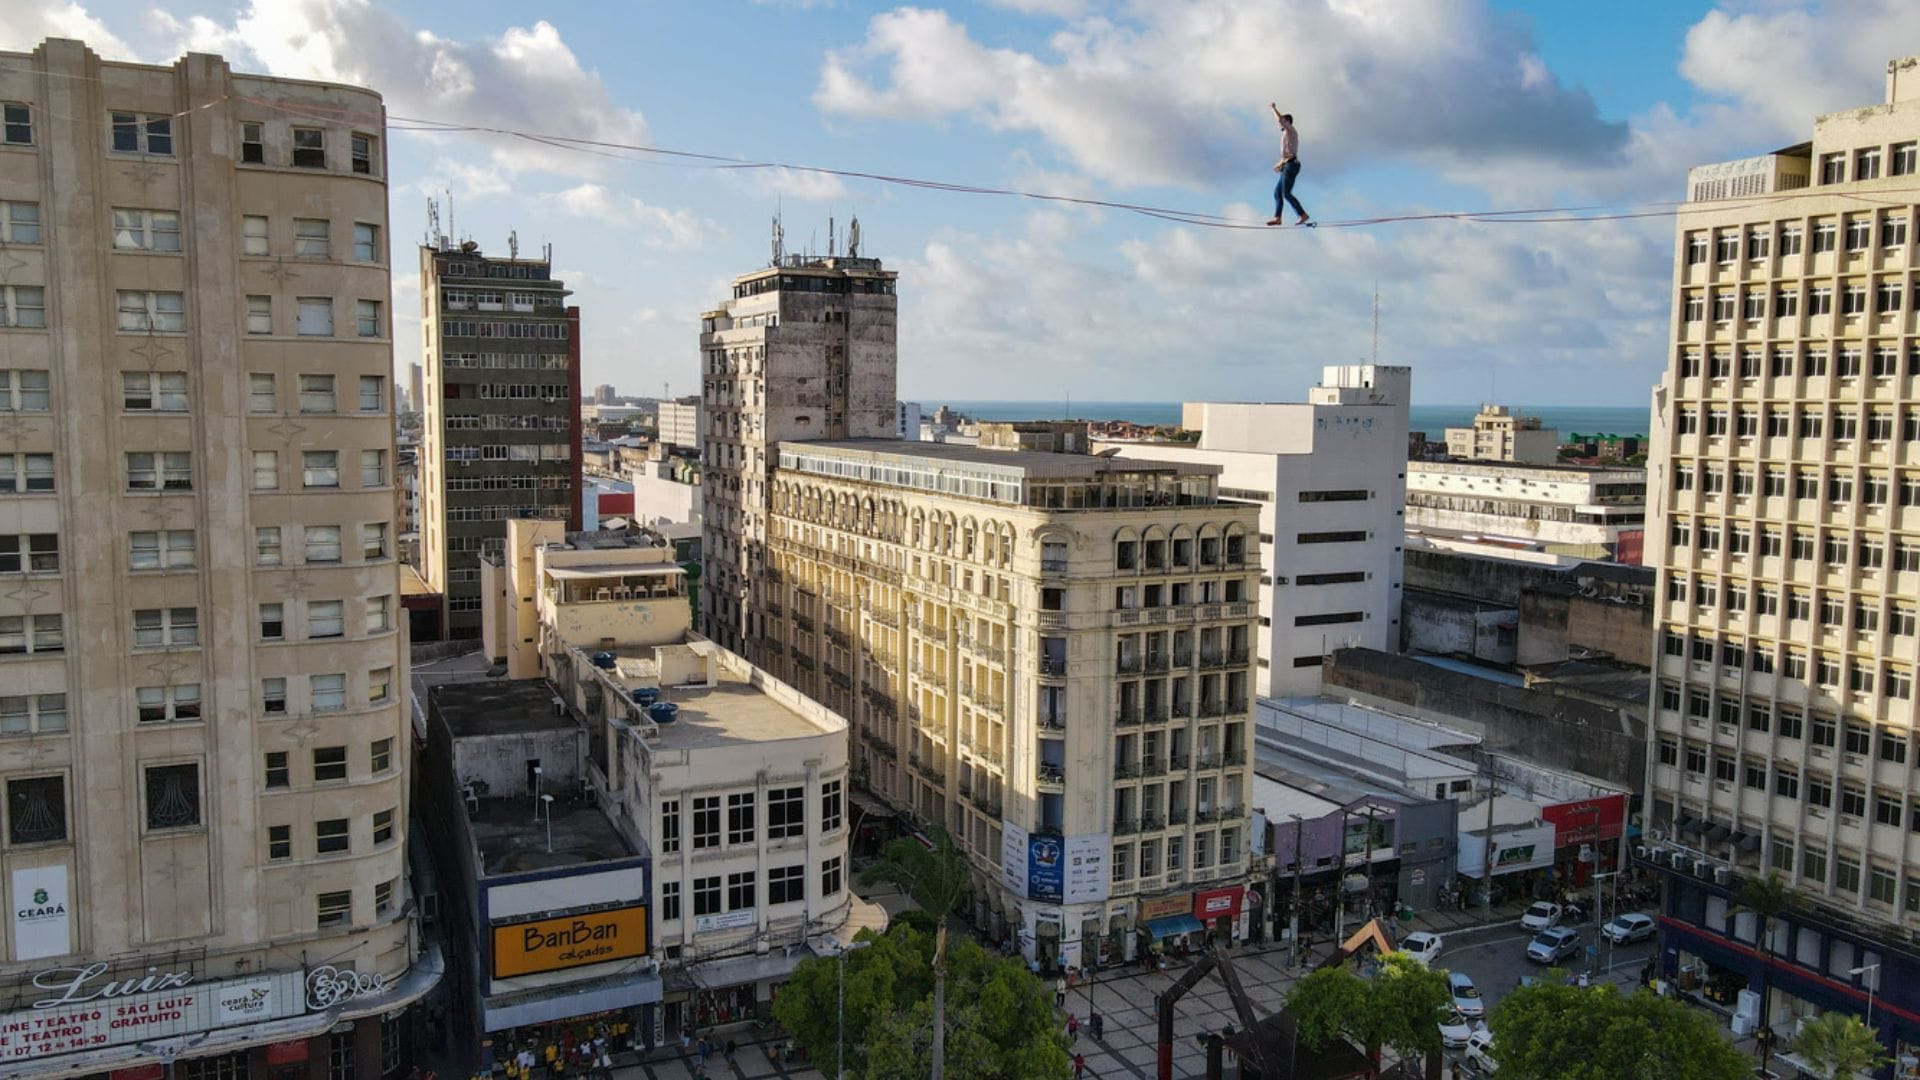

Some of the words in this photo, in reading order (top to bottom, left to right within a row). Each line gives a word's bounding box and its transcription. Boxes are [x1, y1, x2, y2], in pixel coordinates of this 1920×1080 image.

[18, 903, 65, 918] CEARÁ
[524, 920, 618, 953] BanBan
[558, 945, 614, 961] calçados
[32, 962, 195, 1009] Luiz
[221, 995, 249, 1007] ceará
[229, 1001, 265, 1012] cultura
[0, 1022, 30, 1033] INE
[34, 1011, 102, 1028] TEATRO
[116, 1003, 150, 1016] SÃO
[157, 997, 194, 1011] LUIZ
[22, 1026, 83, 1043] TEATRO
[111, 1011, 182, 1029] GRATUITO
[37, 1043, 53, 1053] 12
